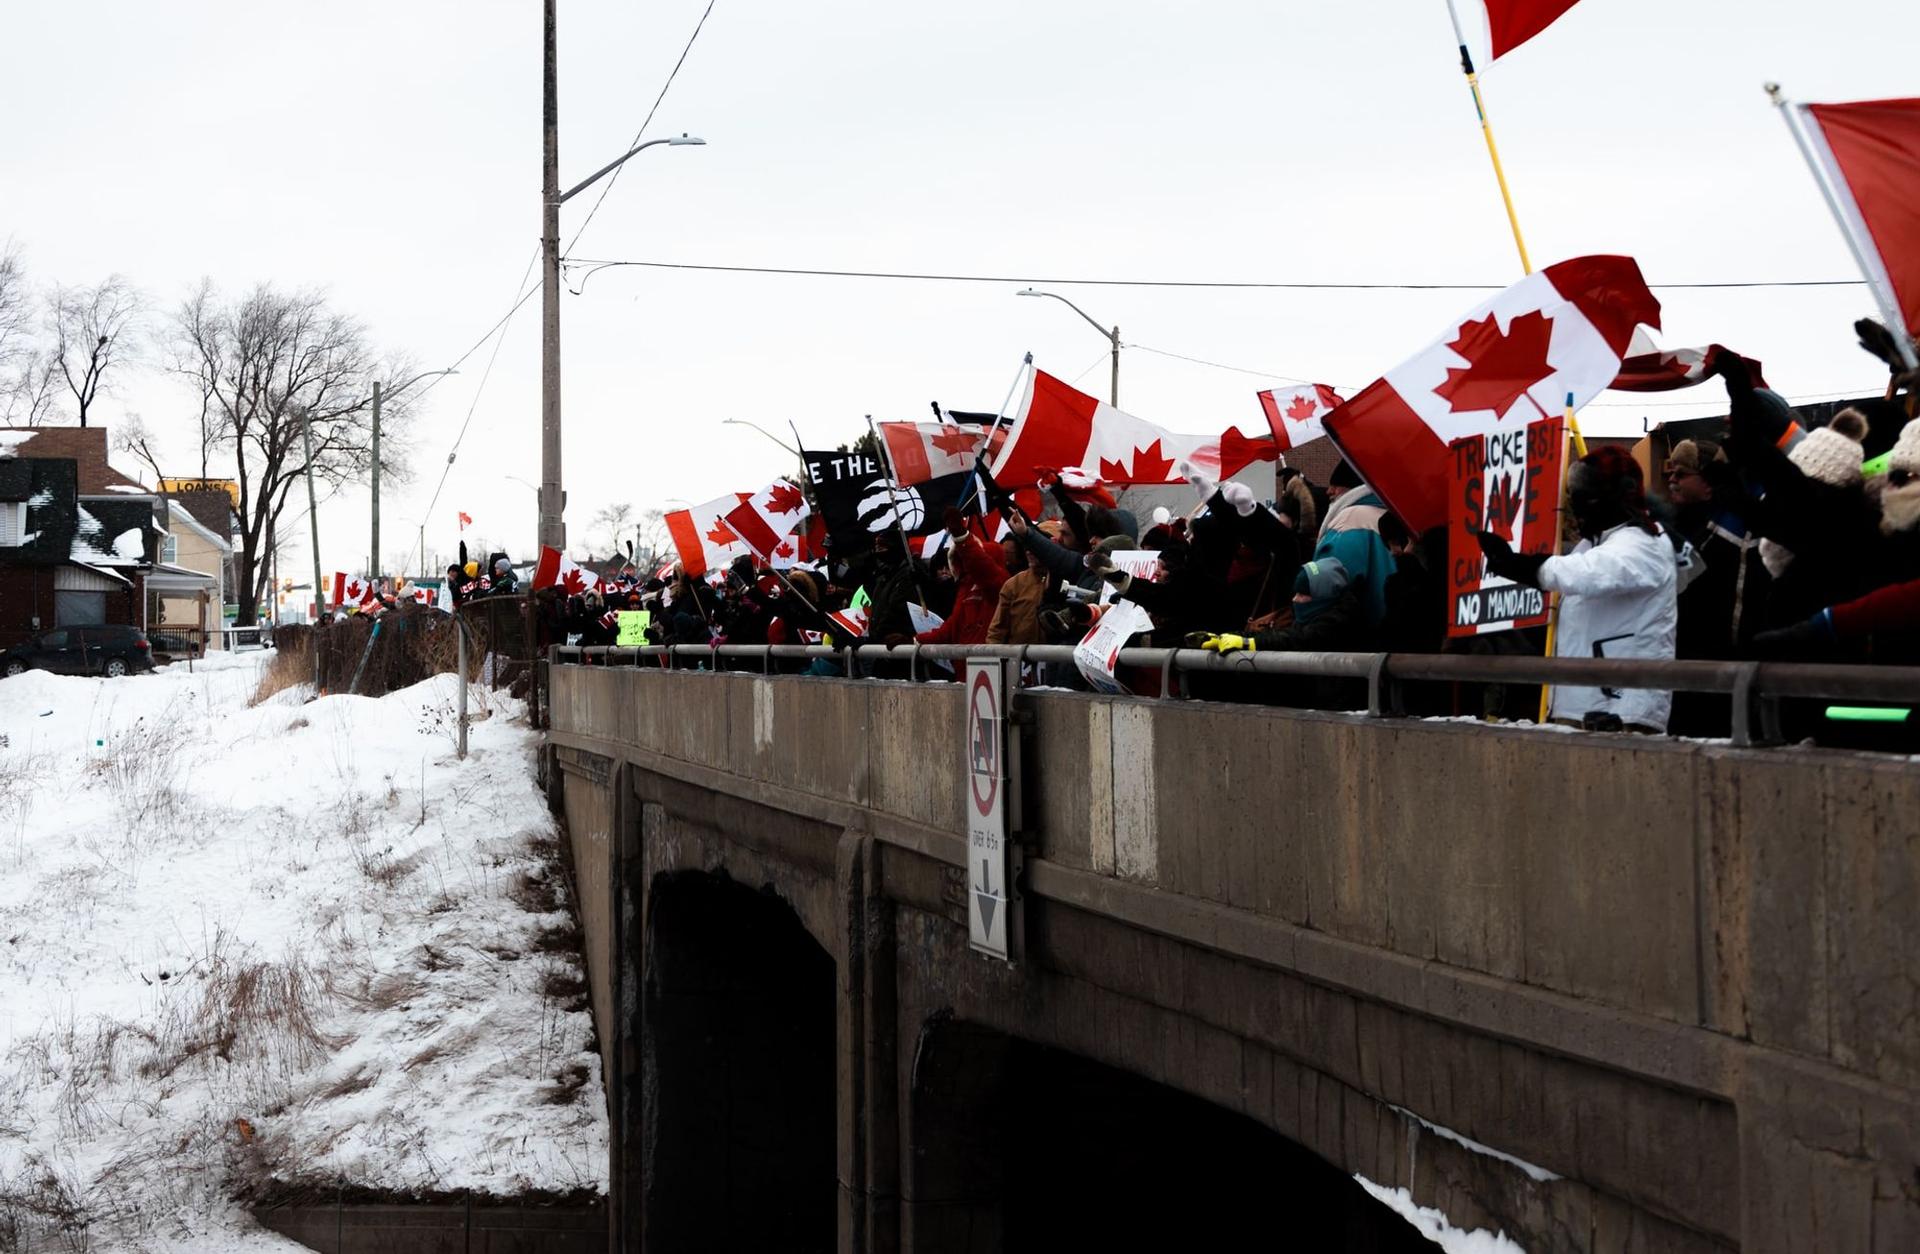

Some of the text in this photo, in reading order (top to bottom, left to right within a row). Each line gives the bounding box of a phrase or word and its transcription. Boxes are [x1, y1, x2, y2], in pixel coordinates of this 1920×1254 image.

[831, 455, 878, 480] THE
[1452, 424, 1555, 480] TRUCKERS!
[177, 483, 221, 492] LOANS
[1465, 465, 1542, 536] SAVE
[1458, 588, 1543, 626] NO MANDATES
